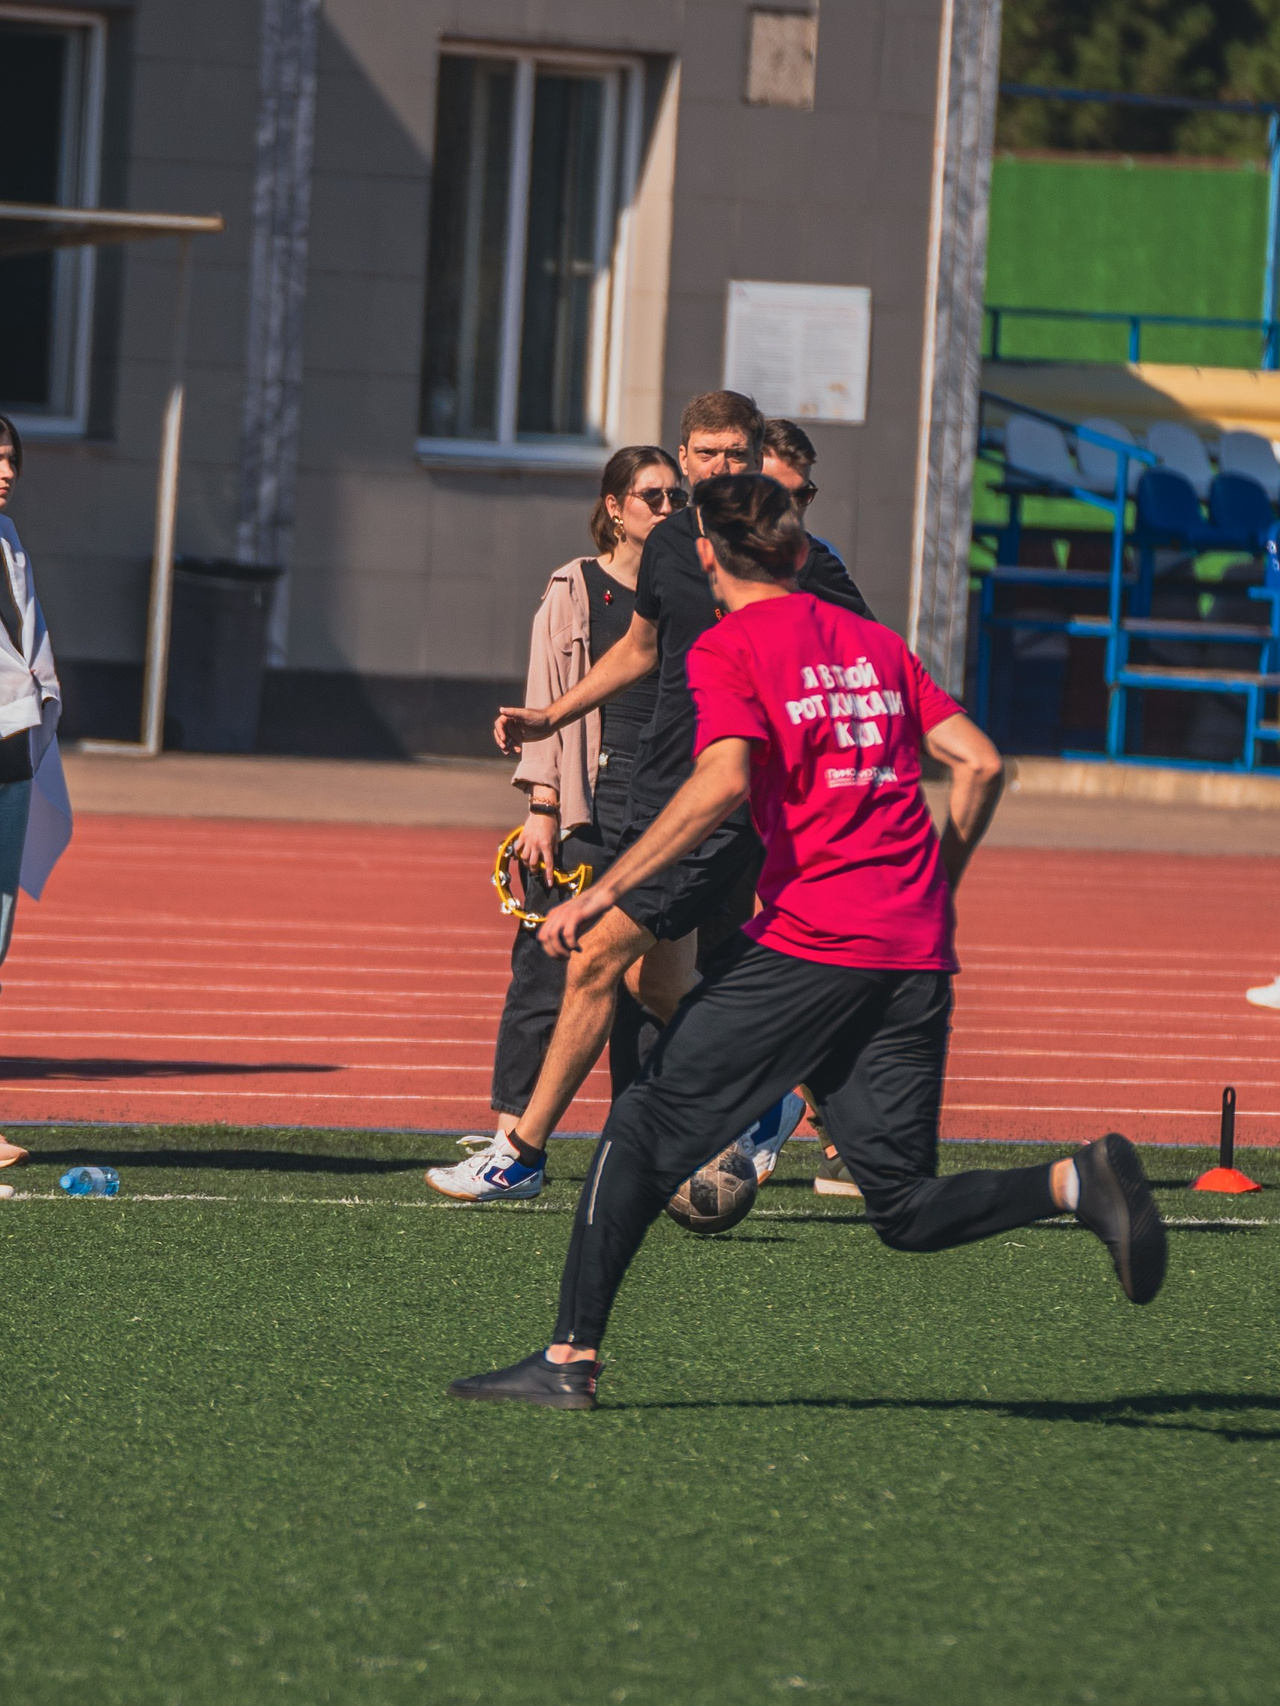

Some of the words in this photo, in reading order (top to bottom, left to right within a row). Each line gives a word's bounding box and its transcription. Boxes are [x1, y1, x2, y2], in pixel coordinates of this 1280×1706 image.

[802, 666, 819, 689] Я
[830, 656, 879, 689] ТОЙ
[785, 695, 827, 725] РОТ
